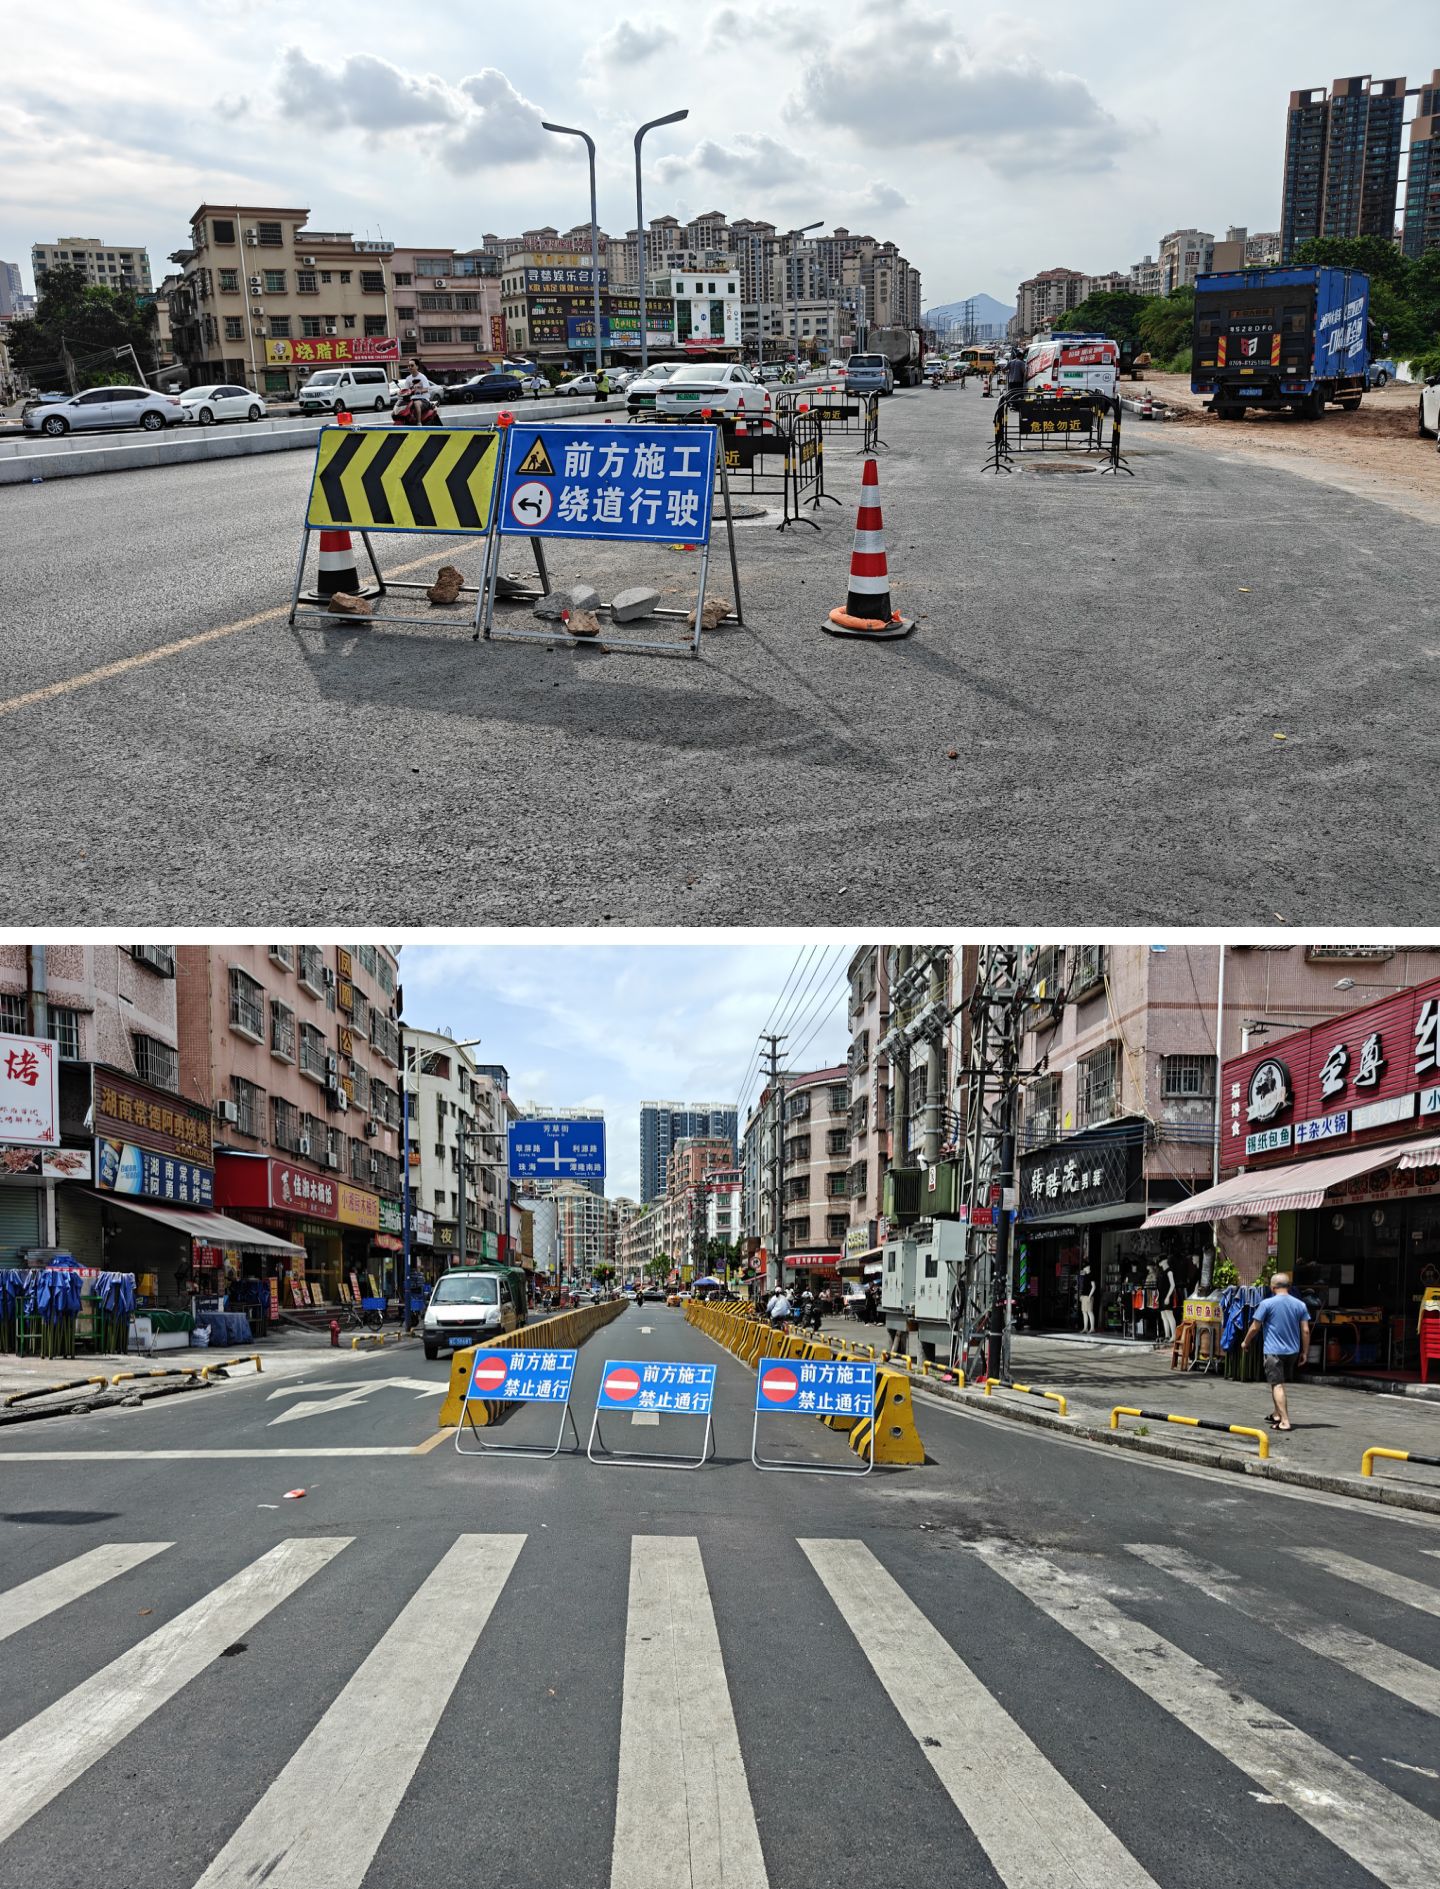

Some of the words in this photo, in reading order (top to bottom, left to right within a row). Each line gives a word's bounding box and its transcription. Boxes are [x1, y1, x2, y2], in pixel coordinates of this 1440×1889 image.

[295, 341, 353, 361] 烧腊匠
[1030, 420, 1082, 433] 危险勿近
[564, 441, 702, 480] 前方施工
[557, 485, 699, 527] 绕道行驶
[4, 1047, 39, 1087] 烤
[101, 1085, 209, 1147] 湖南常德阿勇烧烤
[1296, 1112, 1347, 1142] 牛杂火锅
[1247, 1129, 1290, 1151] 锡纸包鱼
[150, 1156, 201, 1188] 湖南常德
[518, 1163, 537, 1171] 珠海
[150, 1176, 200, 1204] 阿勇烧烤
[440, 1228, 453, 1244] 夜
[509, 1352, 573, 1371] 前方施工
[643, 1364, 712, 1385] 前方施工
[800, 1363, 872, 1385] 前方施工
[503, 1378, 569, 1399] 禁止通行
[638, 1389, 709, 1411] 禁止通行
[798, 1390, 872, 1414] 禁止通行
